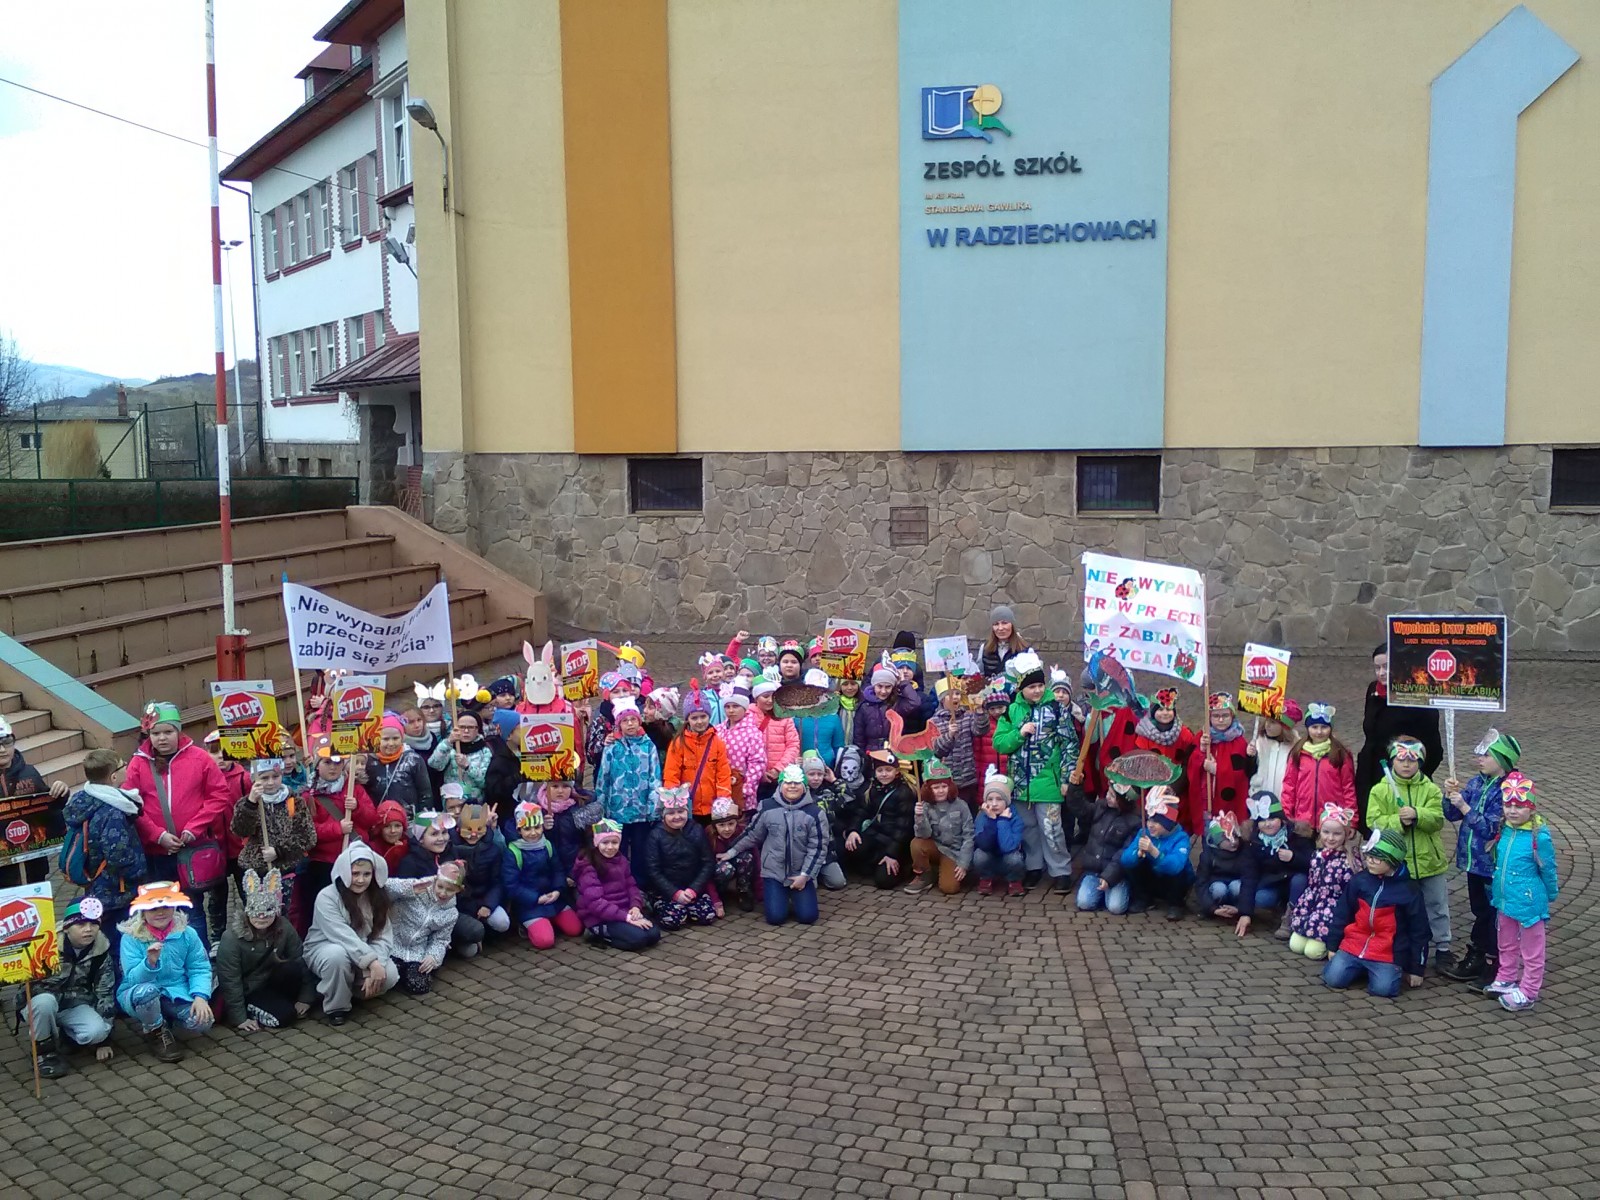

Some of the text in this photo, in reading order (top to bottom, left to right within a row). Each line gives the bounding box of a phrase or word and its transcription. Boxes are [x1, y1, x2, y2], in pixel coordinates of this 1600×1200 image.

[924, 152, 1082, 180] ZESPÓŁ SZKÓŁ
[925, 202, 1032, 215] STANISŁAWA GAWLIKA
[927, 219, 1157, 247] W RADZIECHOWACH
[1088, 568, 1118, 585] NIE
[1085, 596, 1133, 613] TRAW
[335, 609, 406, 636] wypalaj
[1393, 621, 1497, 636] Wypalanie traw zabija
[307, 621, 386, 651] przecież
[829, 635, 856, 648] STOP
[1084, 622, 1203, 656] NIE ZABIJA SI
[299, 641, 346, 661] zabija
[352, 651, 380, 667] się
[566, 654, 588, 672] STOP
[1430, 658, 1453, 671] STOP
[1247, 665, 1275, 678] STOP
[1407, 683, 1443, 695] WYPALAJ
[1451, 686, 1465, 695] NIE
[1467, 685, 1501, 698] ZABIJAJ
[339, 694, 371, 716] STOP
[1245, 695, 1258, 704] 998
[221, 700, 261, 721] STOP
[231, 741, 248, 749] 998
[339, 735, 354, 744] 998
[526, 730, 560, 748] STOP
[530, 765, 545, 773] 998
[8, 826, 27, 838] STOP
[3, 959, 23, 971] 998
